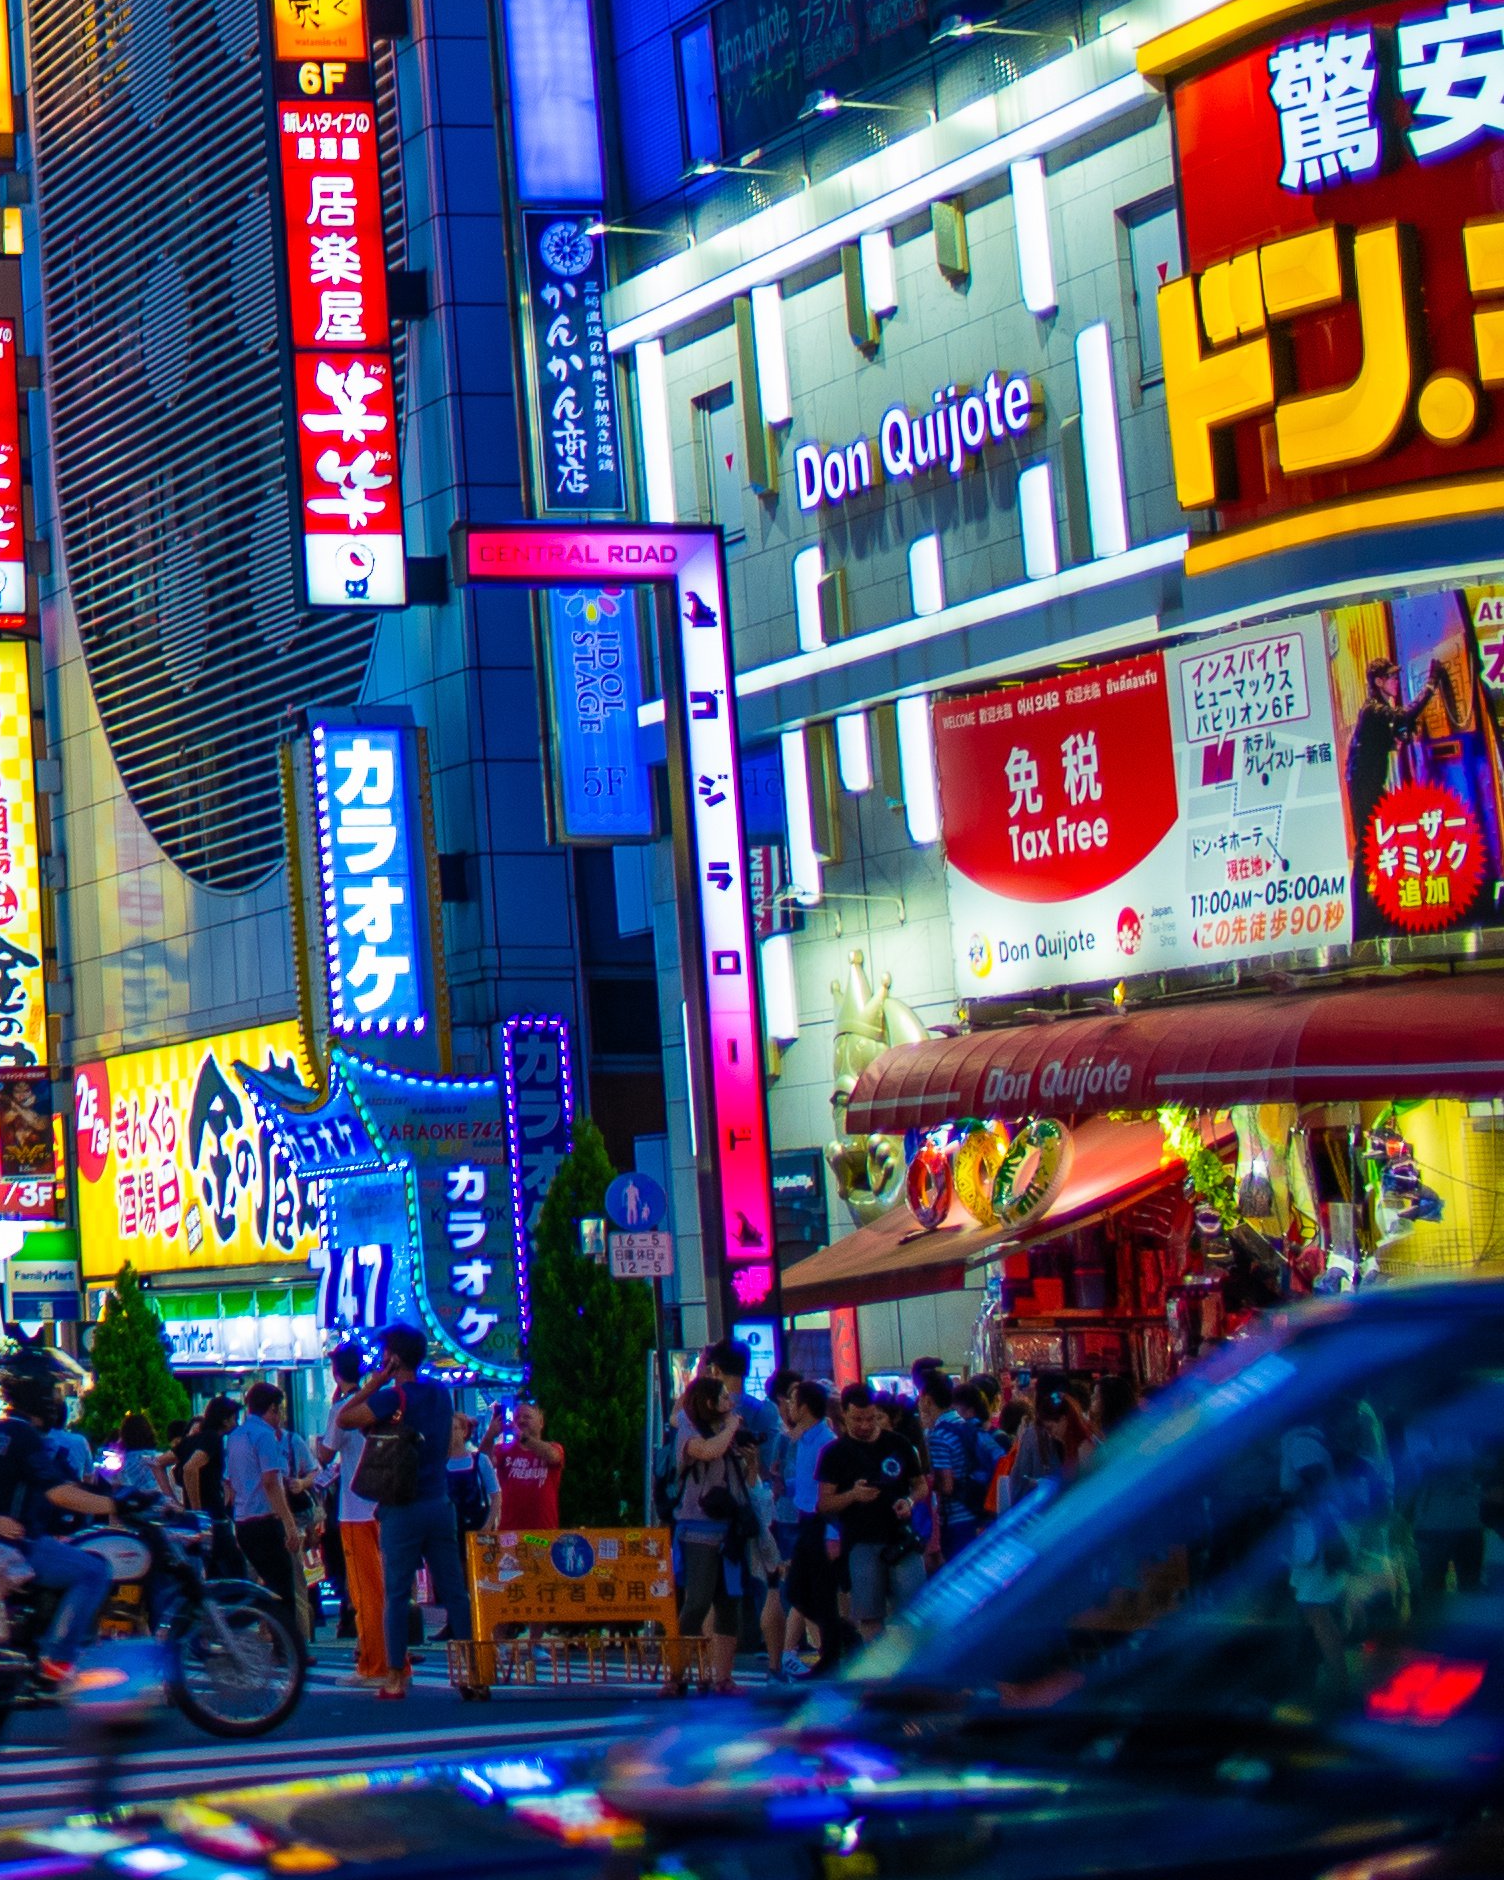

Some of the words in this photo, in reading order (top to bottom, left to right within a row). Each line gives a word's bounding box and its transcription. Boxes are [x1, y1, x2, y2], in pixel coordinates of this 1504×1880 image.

[297, 61, 347, 95] 6F
[306, 175, 367, 343] 居楽屋
[538, 282, 590, 497] かんかん商店
[795, 433, 873, 512] Don
[880, 372, 1035, 475] Quijote
[480, 540, 599, 564] CENTRAL
[608, 541, 678, 564] ROAD
[573, 631, 602, 737] STAGE
[595, 631, 626, 720] IDOL
[942, 710, 977, 730] WELCOME
[1002, 728, 1104, 820] 免税
[333, 738, 412, 1015] カラオケ
[1007, 821, 1054, 864] Tax
[1056, 813, 1110, 857] Free
[1378, 839, 1469, 878] ギミック
[689, 687, 754, 1153] ゴジラロード
[1200, 903, 1345, 949] この先徒歩90秒
[307, 1244, 394, 1328] 747
